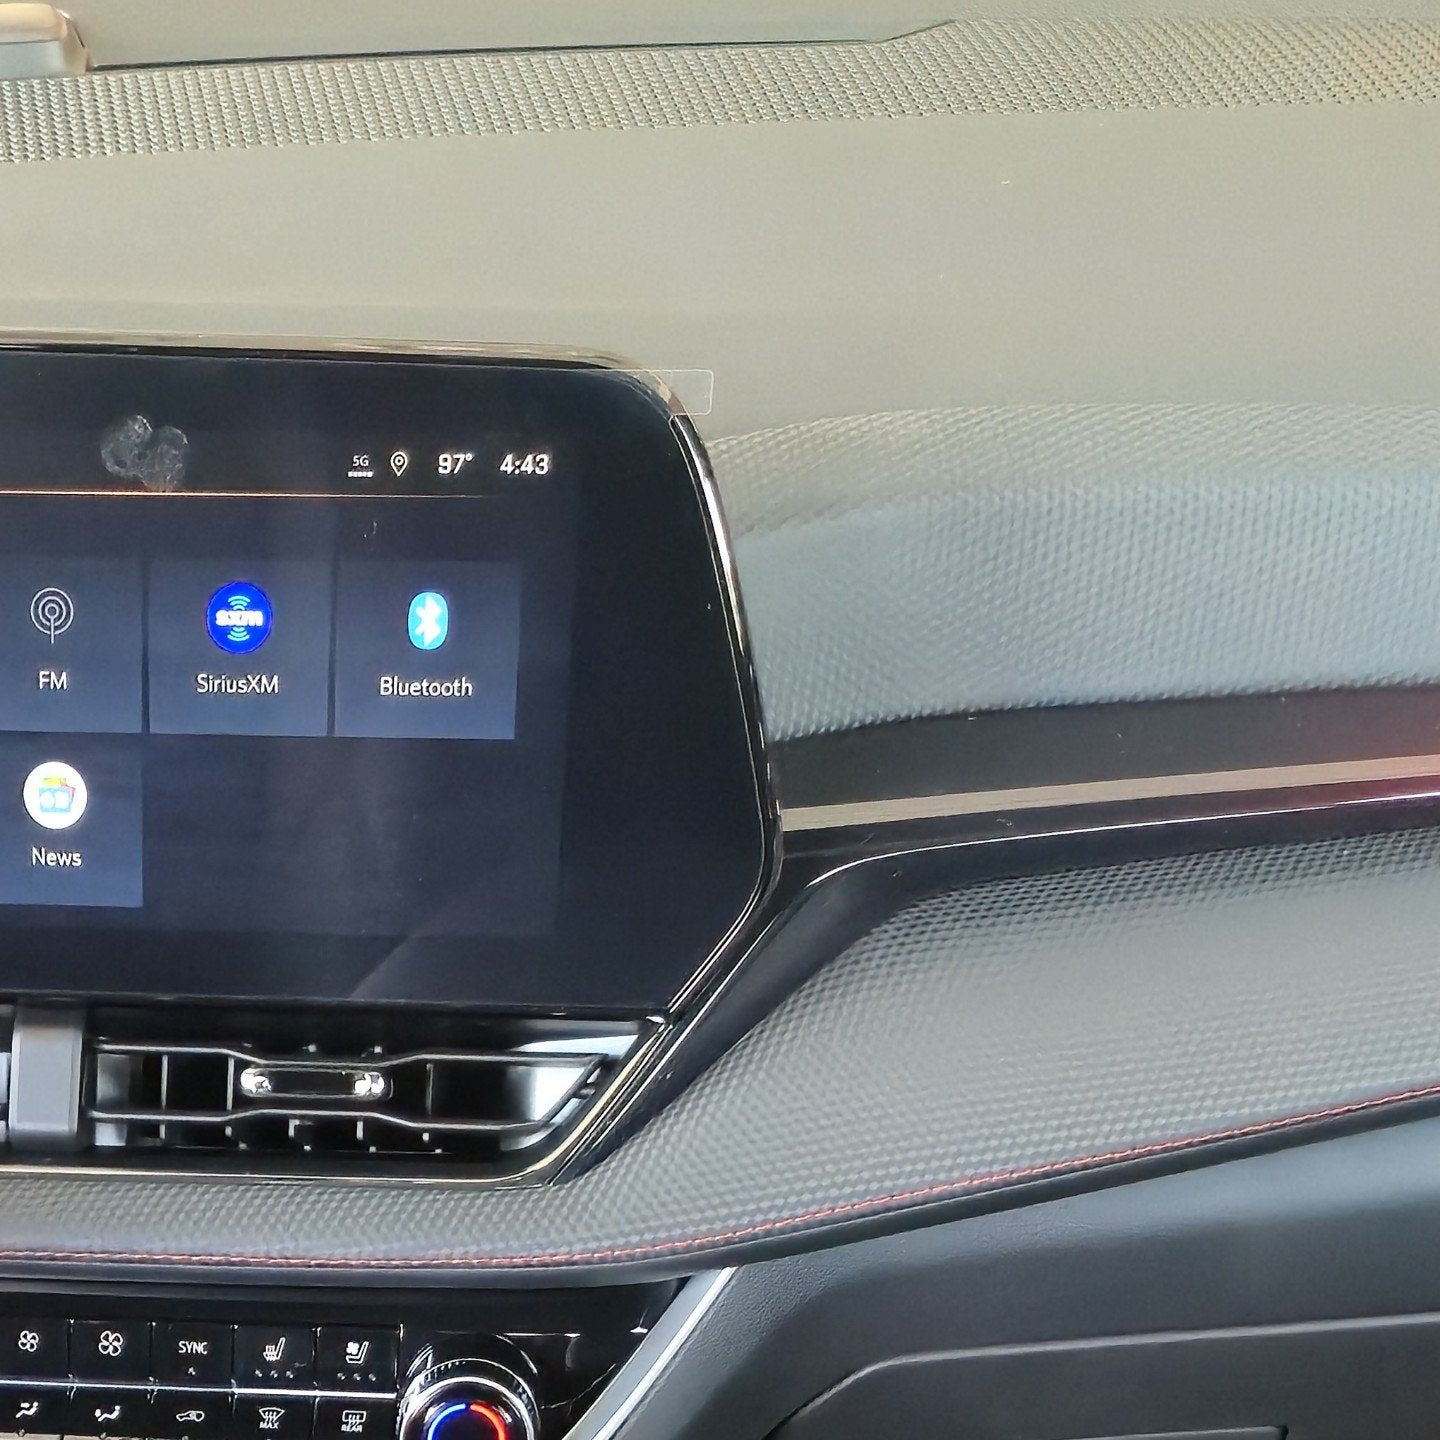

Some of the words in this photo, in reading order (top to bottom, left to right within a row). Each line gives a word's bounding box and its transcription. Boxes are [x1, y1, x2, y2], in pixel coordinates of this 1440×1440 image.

[352, 454, 369, 467] 5G
[437, 453, 473, 475] 97°
[499, 453, 550, 475] 4:43
[38, 671, 68, 691] FM
[195, 673, 280, 695] SiriusXM
[379, 676, 473, 698] Bluetooth
[31, 846, 82, 867] News
[178, 1340, 208, 1356] SYNC
[259, 1420, 280, 1430] MAX
[340, 1423, 364, 1433] REAR
